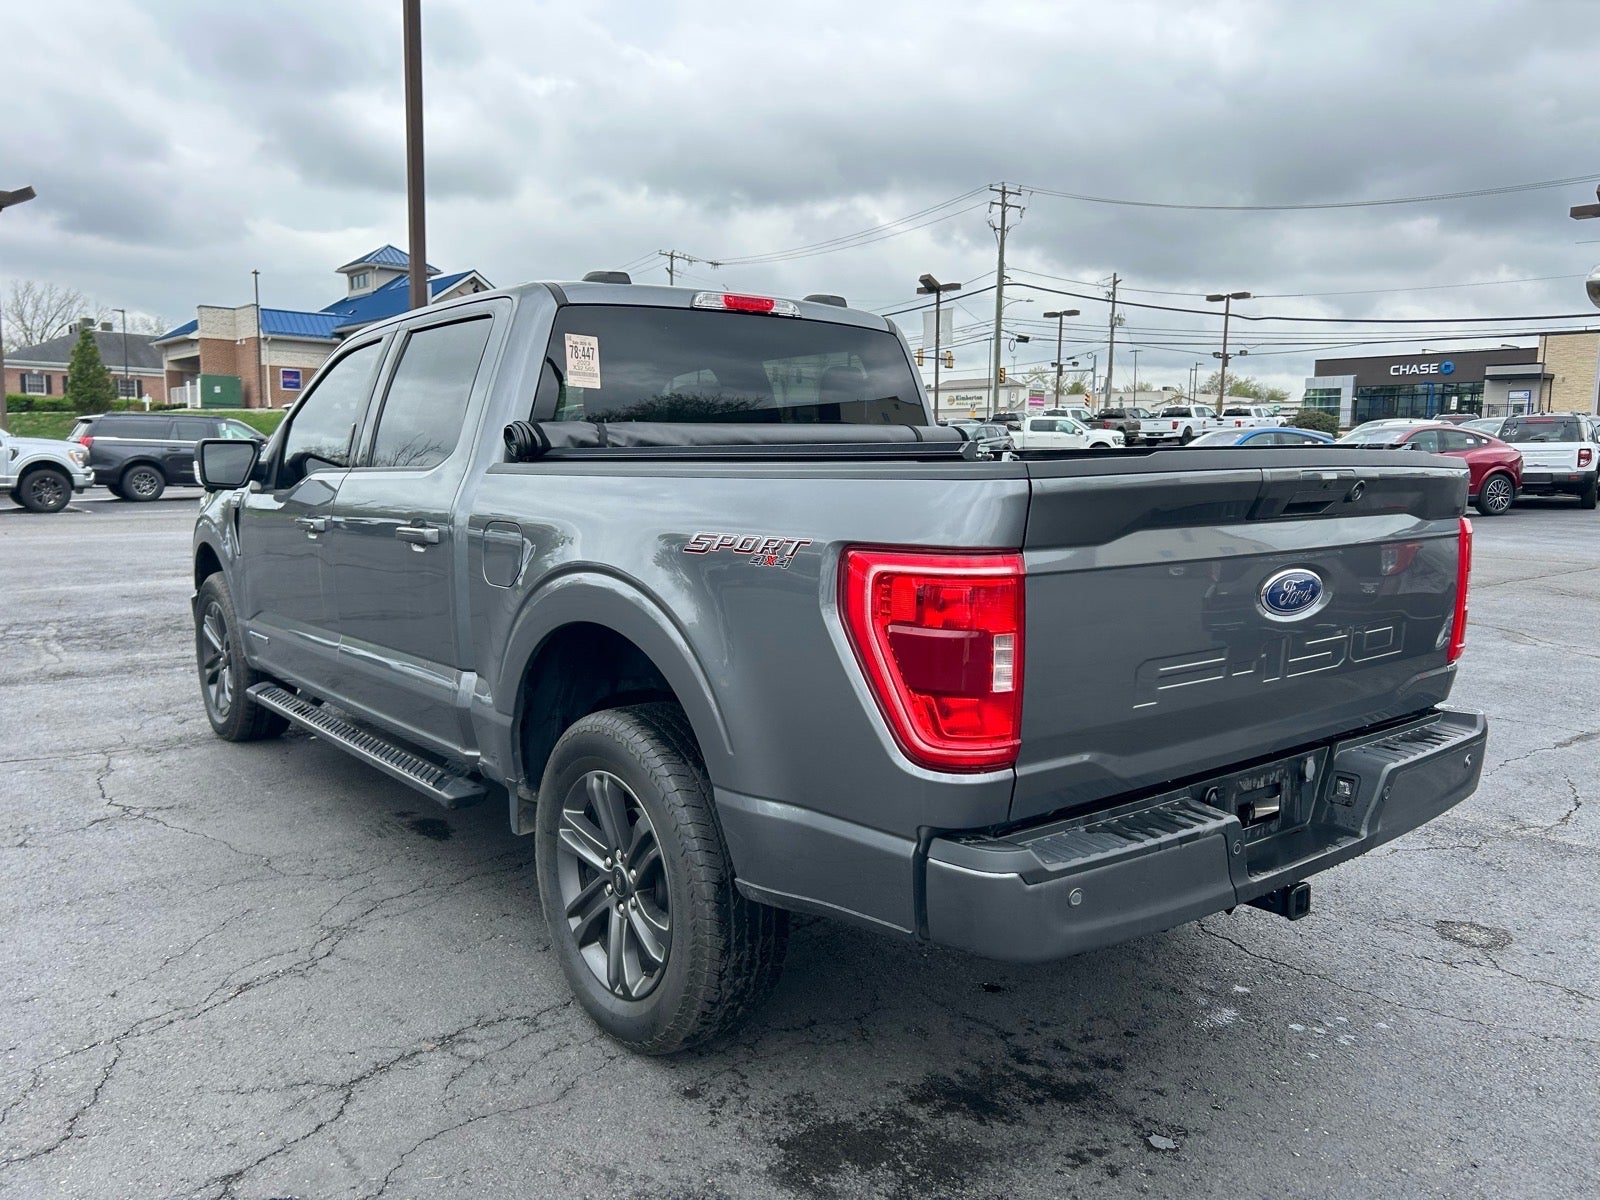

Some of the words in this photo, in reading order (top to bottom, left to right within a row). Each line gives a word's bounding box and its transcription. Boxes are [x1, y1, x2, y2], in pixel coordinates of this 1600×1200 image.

[569, 345, 595, 360] 78:447
[1390, 363, 1439, 376] CHASE
[683, 531, 813, 557] SPORT
[1279, 579, 1313, 606] Ford
[1133, 620, 1406, 709] F-150
